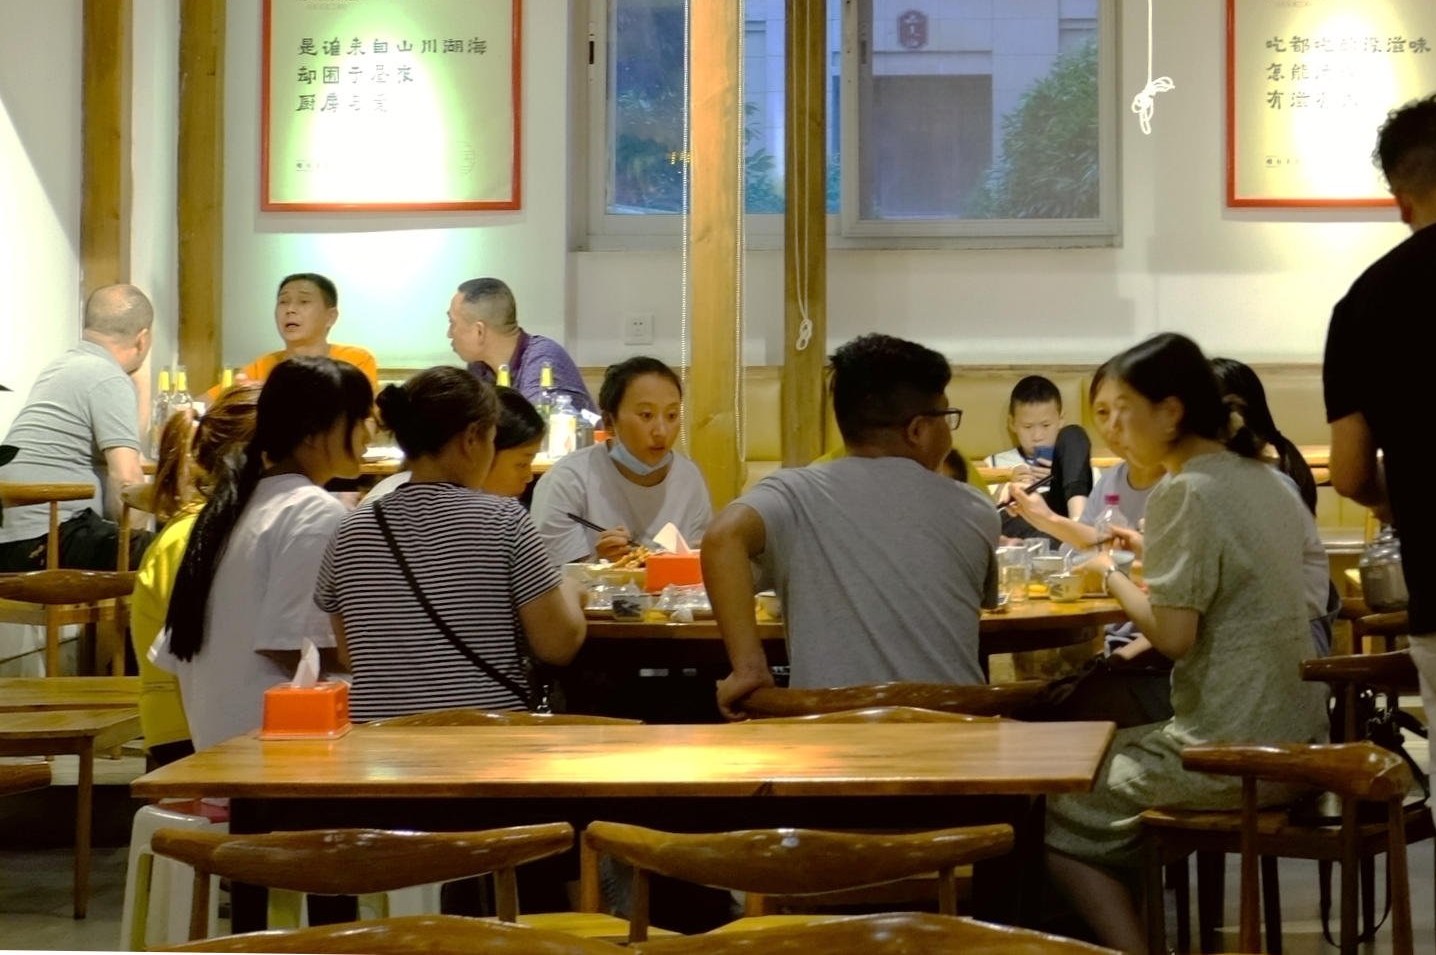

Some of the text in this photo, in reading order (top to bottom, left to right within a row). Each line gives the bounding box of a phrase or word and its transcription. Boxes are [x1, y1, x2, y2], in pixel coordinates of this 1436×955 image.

[297, 37, 488, 57] 是谁来自山川湖海
[1266, 36, 1432, 54] 吃都吃没滋味
